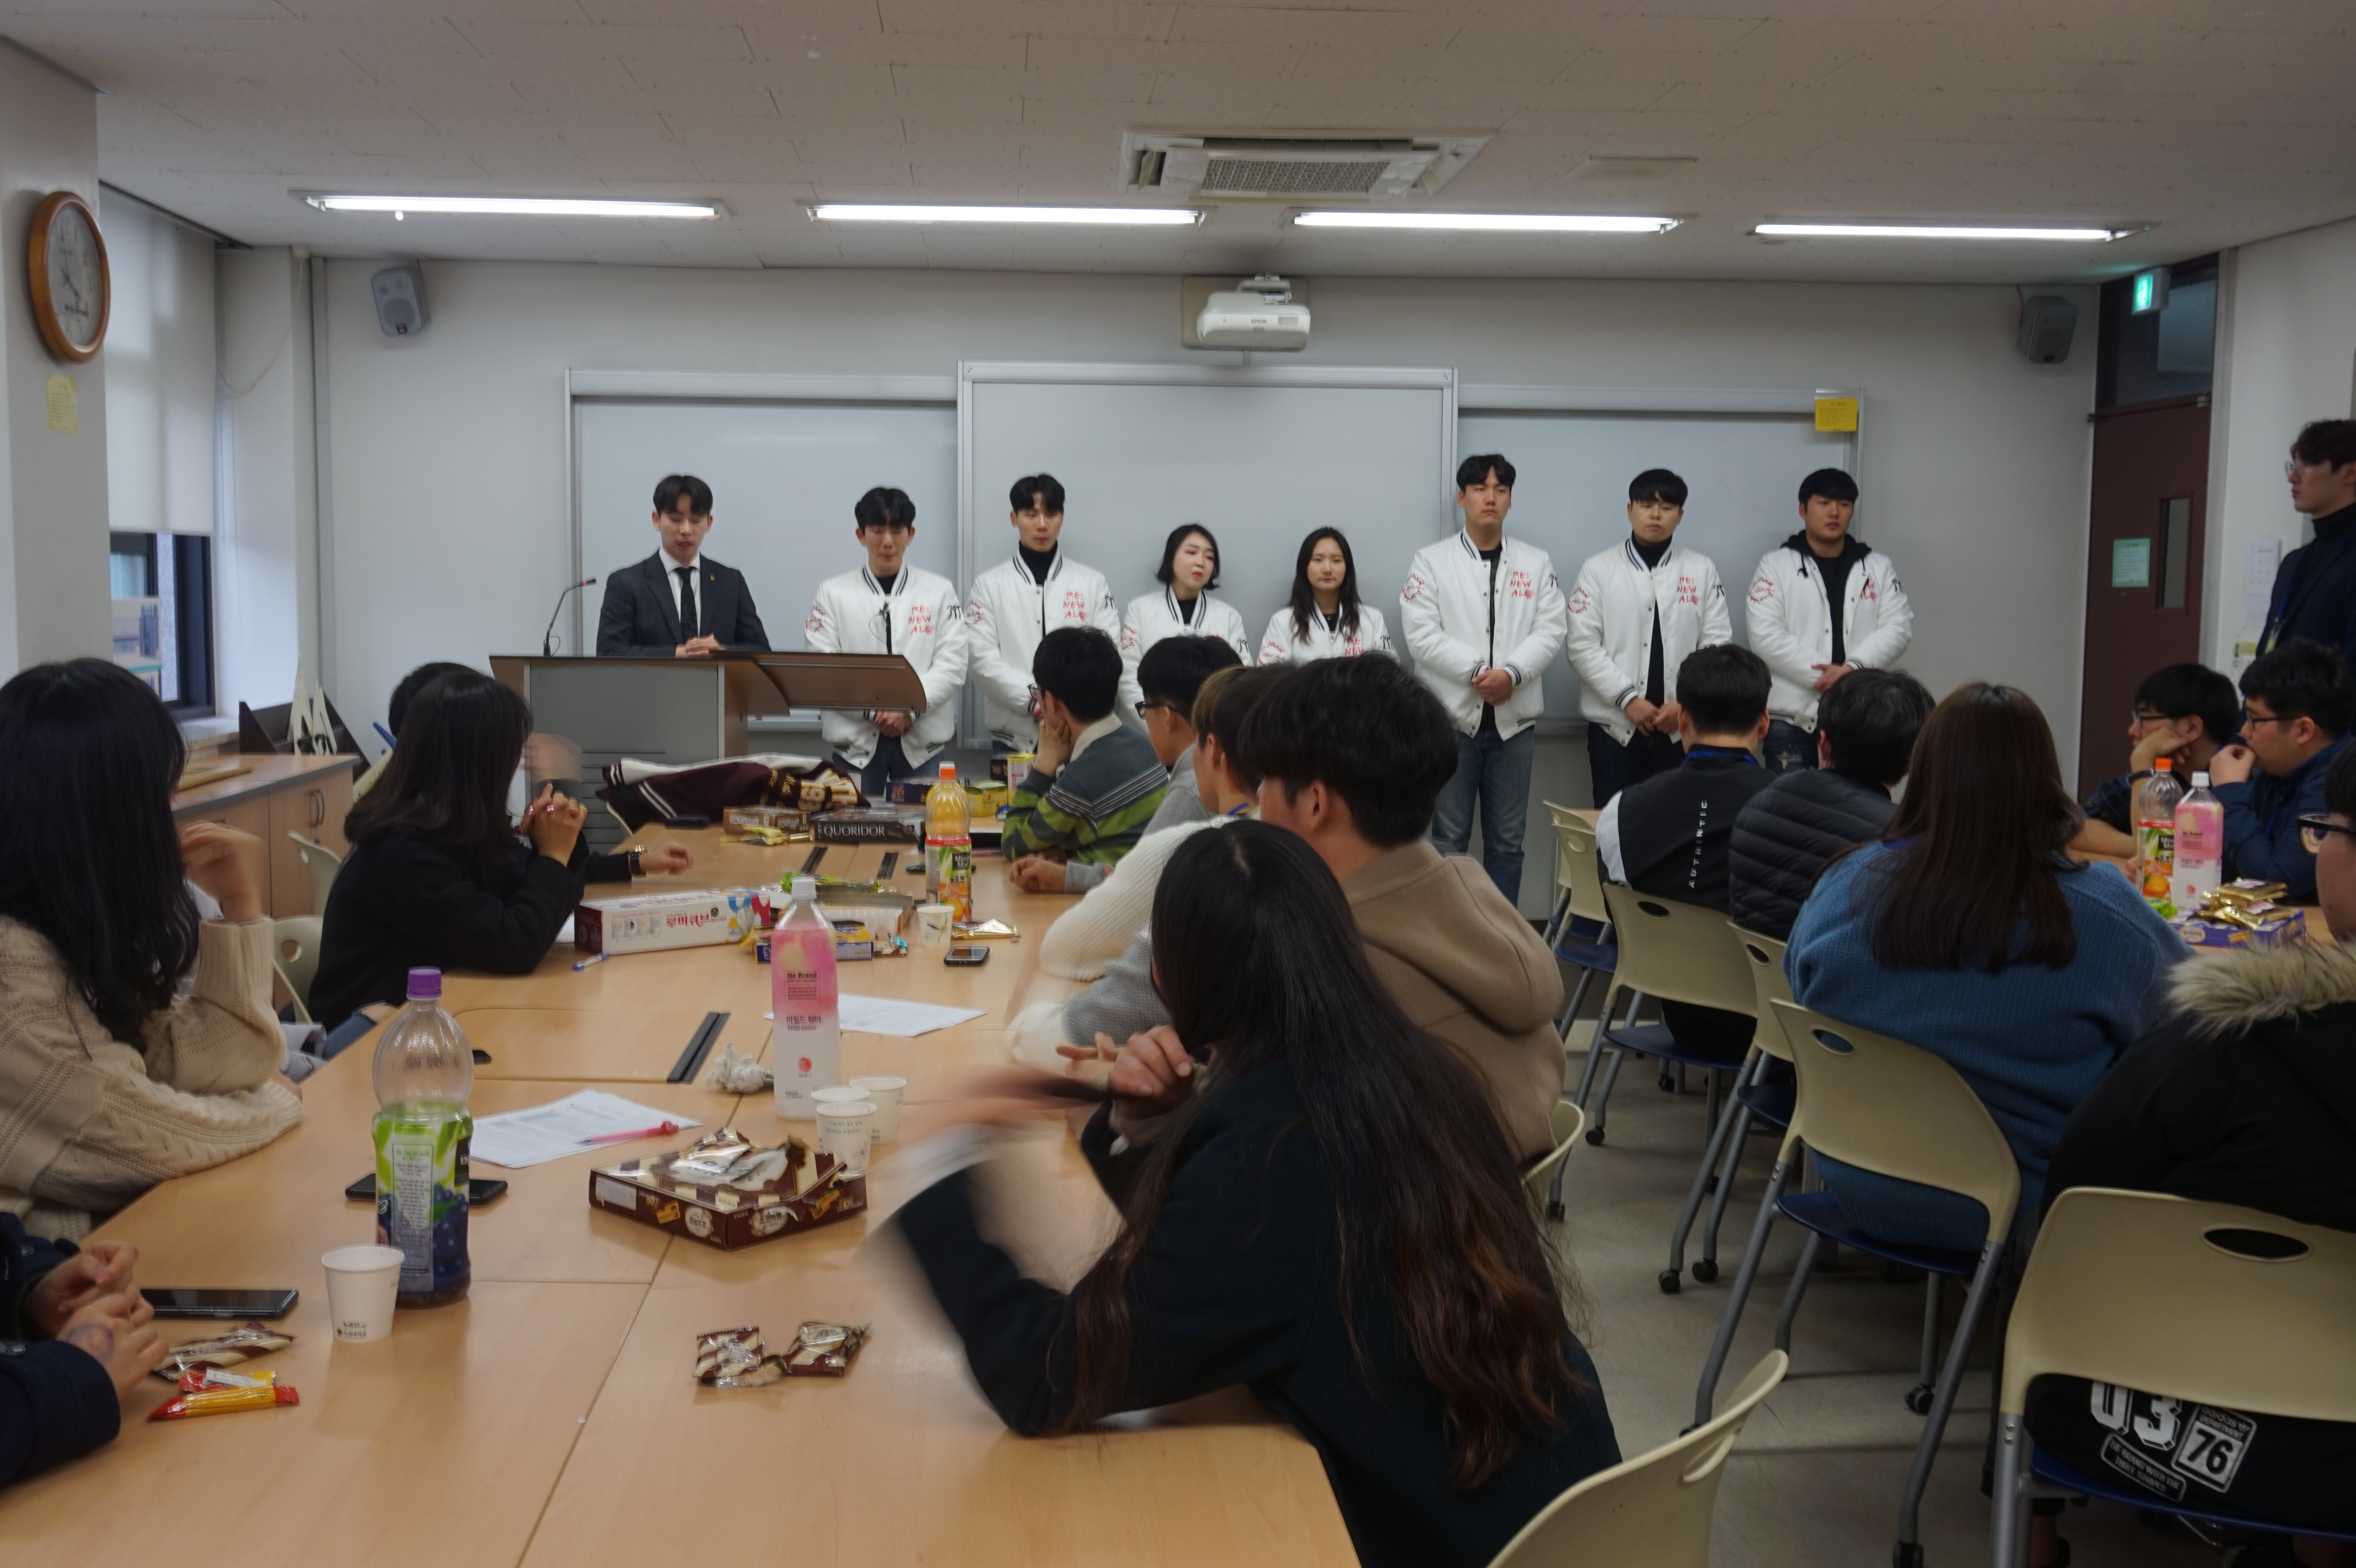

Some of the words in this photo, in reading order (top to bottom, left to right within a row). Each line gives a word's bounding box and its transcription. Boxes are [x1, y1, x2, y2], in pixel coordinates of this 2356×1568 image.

[1063, 601, 1085, 609] NEW
[1678, 596, 1697, 604] ALL
[909, 615, 931, 624] NEW
[911, 626, 931, 635] ALL
[824, 824, 885, 838] QUORIDOR
[1688, 800, 1708, 889] AUTHENTIC
[666, 914, 710, 928] 루미큐브
[786, 1015, 806, 1024] 마일드
[808, 1015, 821, 1024] 워터
[2200, 1415, 2244, 1441] DEPARTMENT
[2187, 1428, 2234, 1475] 76
[2109, 1439, 2122, 1454] THE
[2121, 1448, 2146, 1470] BRAND
[2145, 1465, 2166, 1482] WITH
[2166, 1476, 2182, 1489] THE
[2115, 1455, 2135, 1475] THREE
[2136, 1470, 2166, 1493] STRIPES
